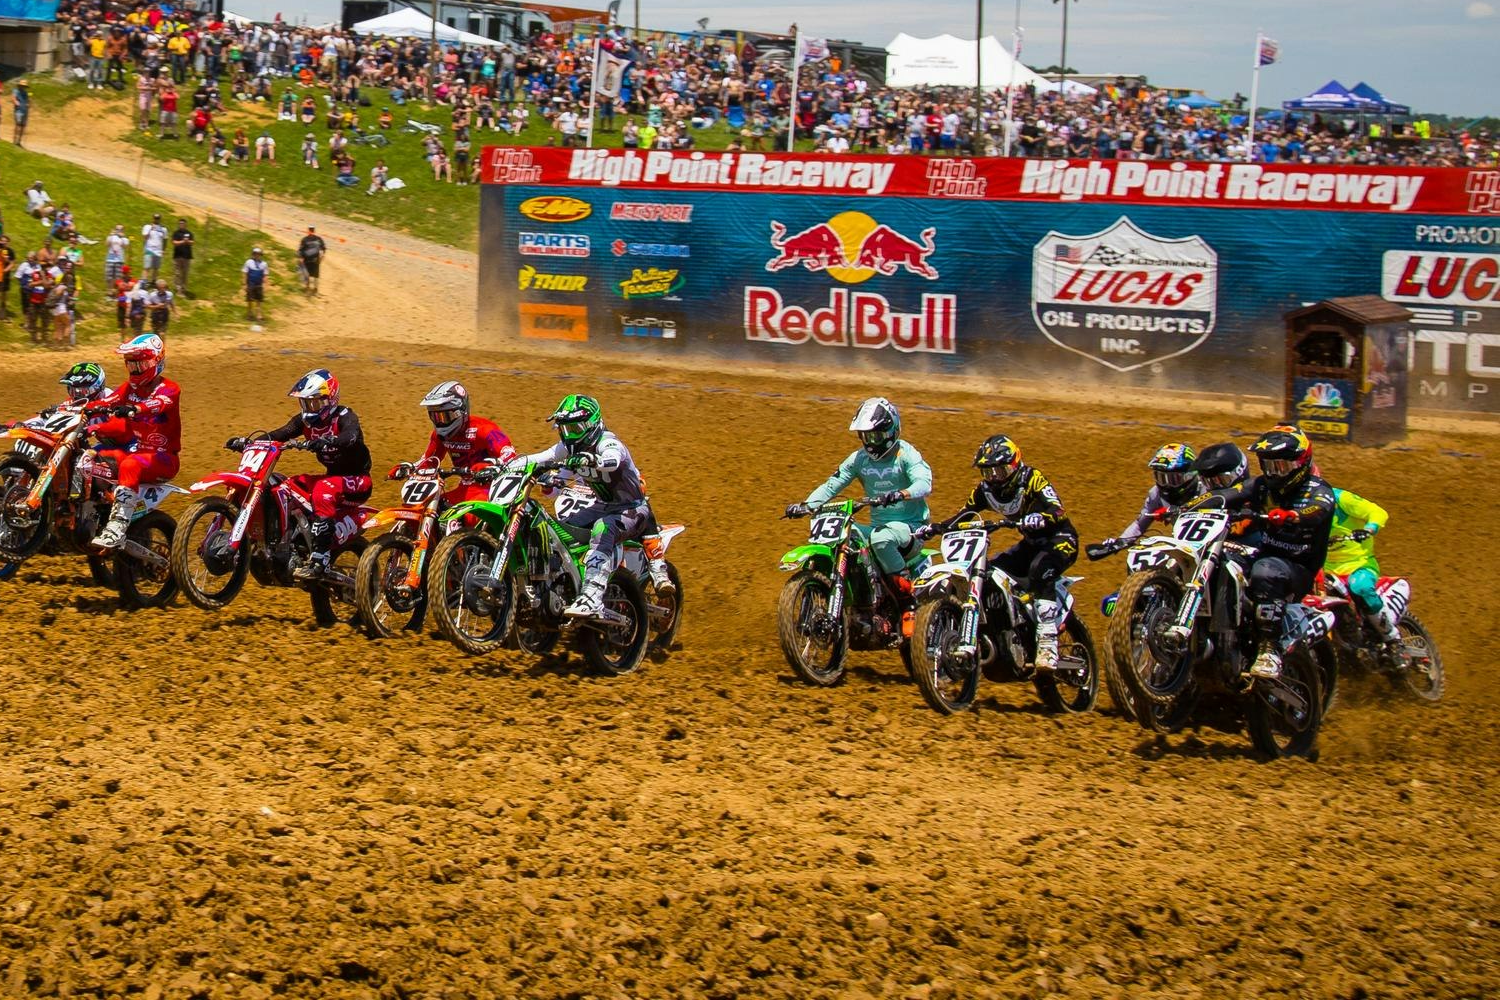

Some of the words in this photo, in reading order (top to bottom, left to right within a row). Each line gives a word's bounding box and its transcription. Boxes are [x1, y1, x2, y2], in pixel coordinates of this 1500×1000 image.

[492, 148, 533, 168] High
[926, 158, 977, 179] High
[494, 164, 543, 183] Point
[568, 149, 643, 185] High
[643, 151, 736, 184] Point
[734, 153, 895, 195] Raceway
[928, 176, 988, 197] Point
[1019, 159, 1111, 200] High
[1112, 161, 1224, 198] Point
[1224, 164, 1425, 211] Raceway
[519, 199, 592, 216] FMF
[520, 234, 588, 249] PARTS
[520, 246, 589, 257] UNLIMITED
[627, 242, 690, 257] SUZUKI
[533, 274, 588, 291] THOR
[1053, 268, 1204, 306] LUCAS
[1394, 256, 1500, 300] LUC
[620, 315, 677, 328] GoPro
[744, 286, 848, 347] Red
[851, 292, 957, 354] Bull
[1042, 310, 1080, 328] OIL
[1085, 312, 1205, 334] PRODUCTS
[1100, 337, 1146, 355] INC.
[45, 415, 76, 433] 4
[238, 449, 268, 473] 94
[145, 487, 158, 502] 4
[402, 481, 434, 503] 19
[489, 477, 520, 503] 17
[558, 497, 590, 521] 25
[334, 514, 358, 545] 94
[810, 517, 841, 541] 43
[1177, 519, 1215, 542] 16
[946, 538, 980, 562] 21
[832, 588, 845, 619] DUNLOP
[1387, 589, 1407, 623] 101
[964, 609, 974, 644] DUNLOP
